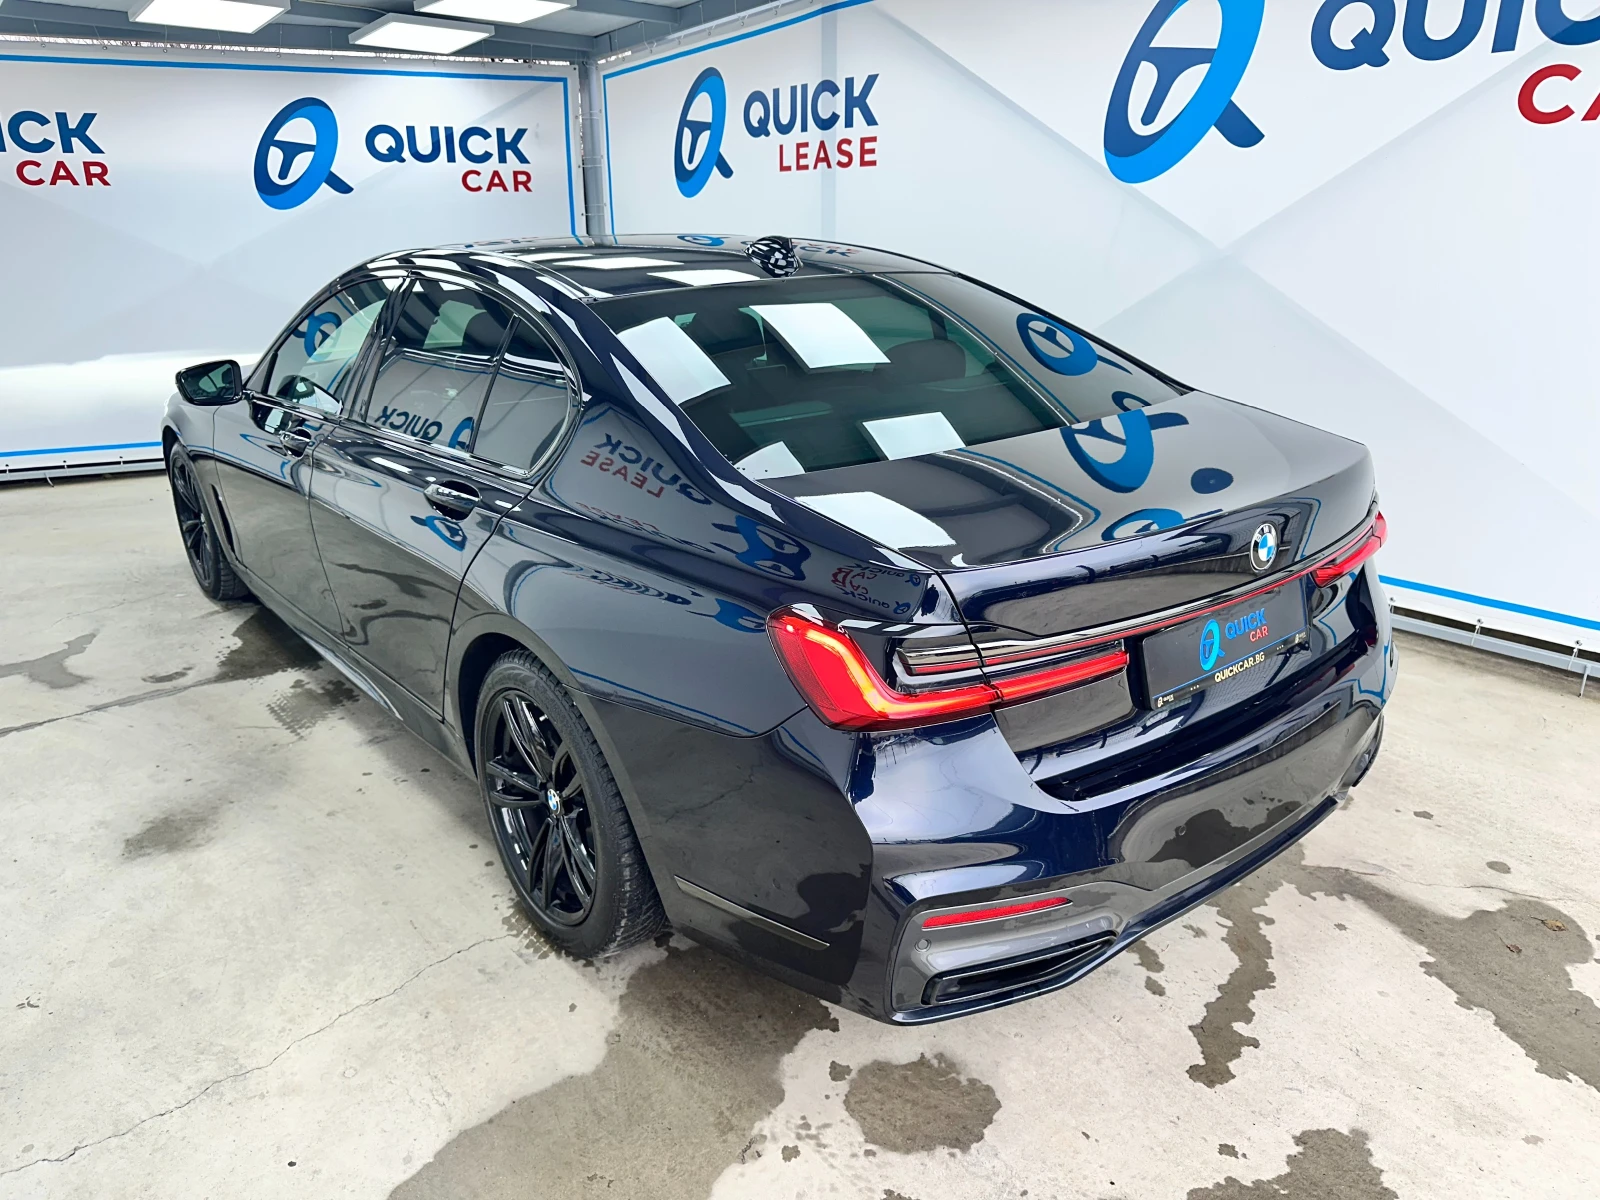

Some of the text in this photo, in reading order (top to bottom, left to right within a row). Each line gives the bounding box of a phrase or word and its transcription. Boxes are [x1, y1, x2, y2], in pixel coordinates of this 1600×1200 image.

[743, 73, 880, 139] QUICK
[1517, 63, 1600, 125] C
[0, 110, 106, 154] CK
[365, 124, 531, 164] QUICK
[779, 135, 878, 172] LEASE
[16, 159, 112, 186] CAR
[461, 169, 533, 192] CAR
[1225, 607, 1267, 639] QUICK
[1249, 625, 1269, 642] CAR
[1214, 651, 1265, 683] QUICKCAR.BG
